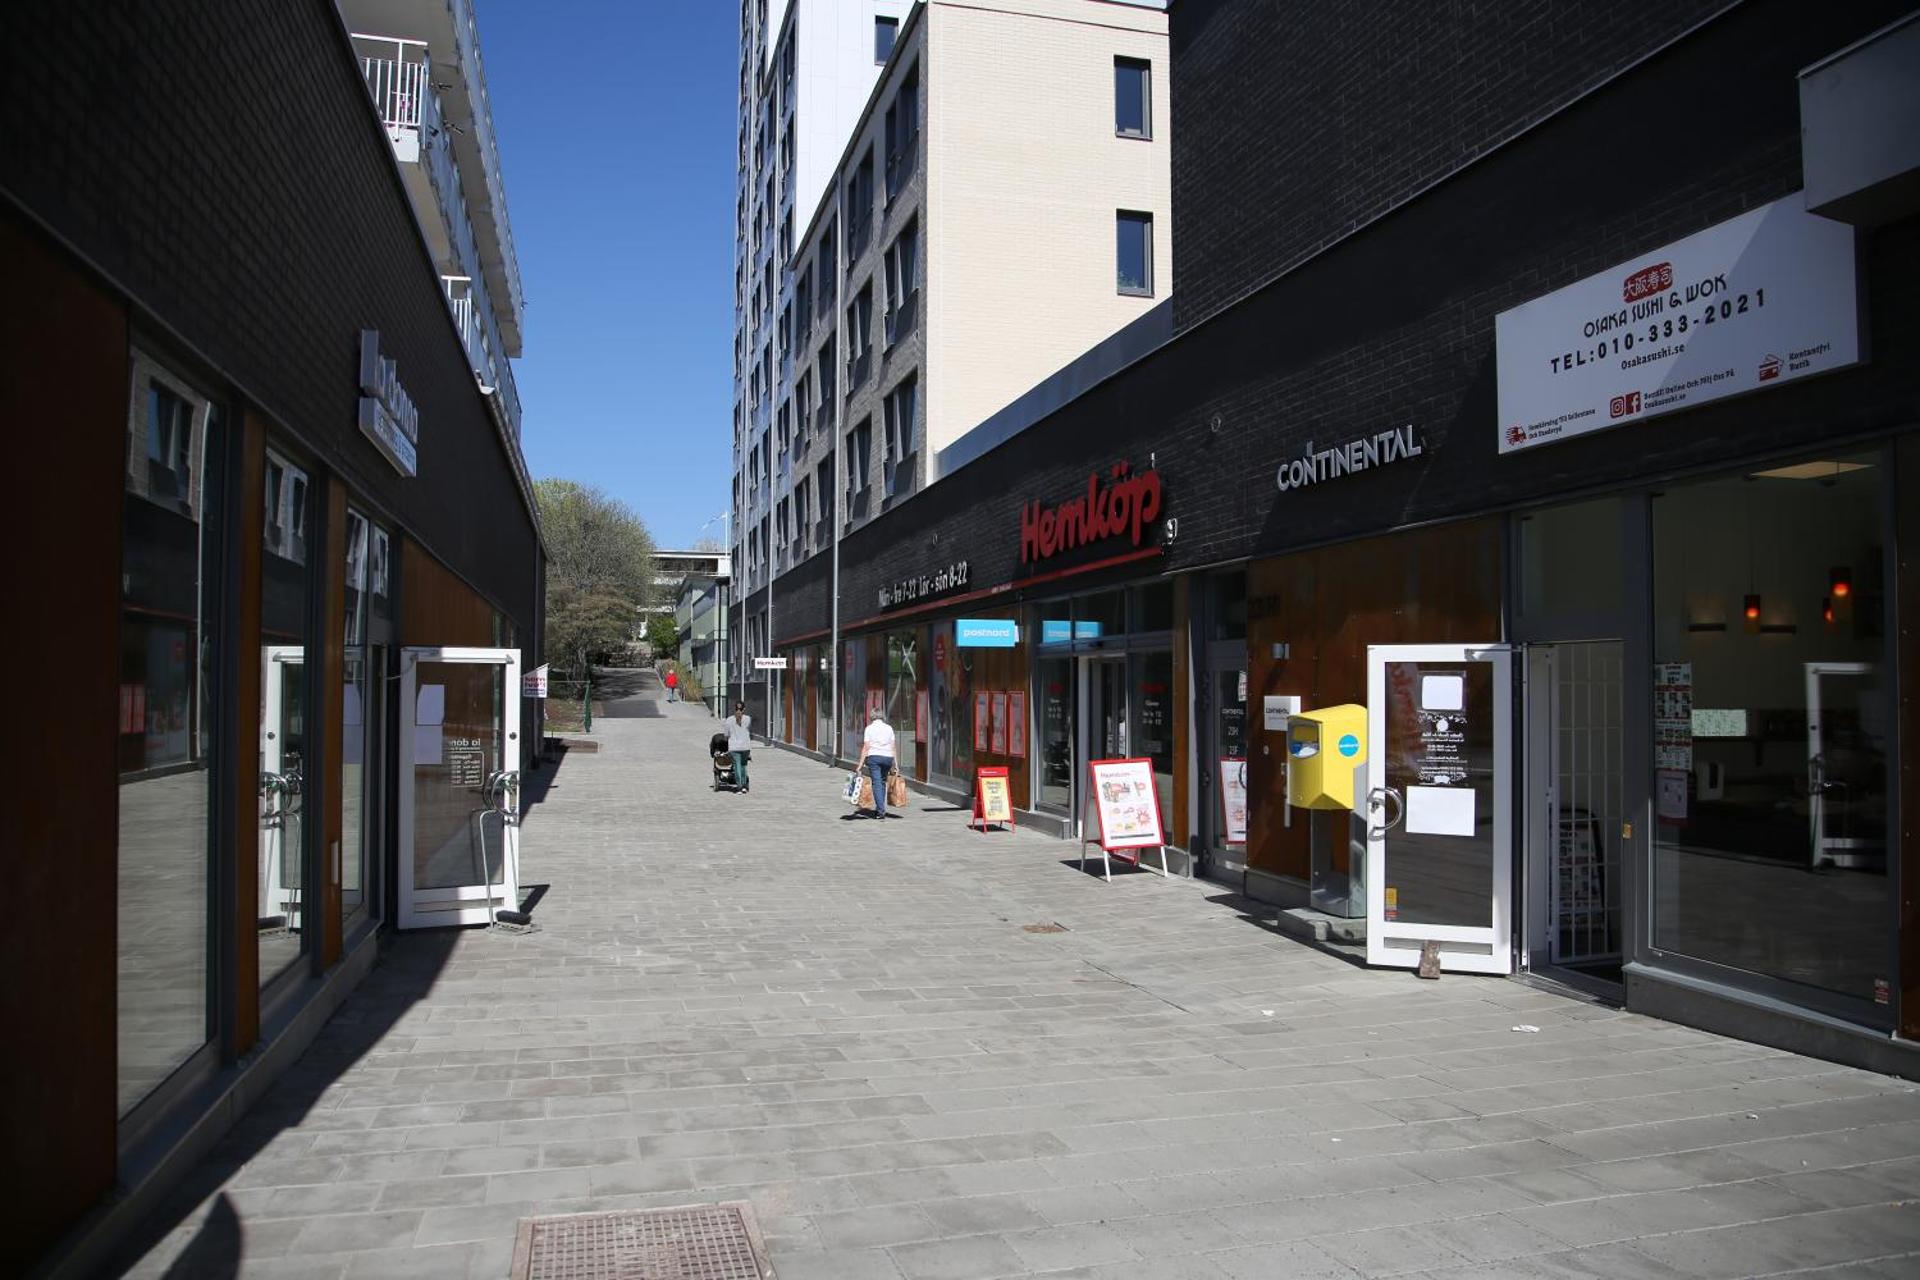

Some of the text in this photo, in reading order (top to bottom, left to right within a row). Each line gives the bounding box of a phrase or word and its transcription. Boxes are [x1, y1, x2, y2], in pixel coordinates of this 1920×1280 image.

[1624, 266, 1674, 297] 大阪寿司
[1584, 273, 1727, 338] OSAKA SUSHI & WOK
[1621, 343, 1685, 370] Osakasushi.se
[1277, 425, 1422, 491] CONTINENTAL
[1019, 460, 1162, 564] Hemköp
[949, 560, 967, 588] 8-22
[963, 629, 1010, 638] postnord
